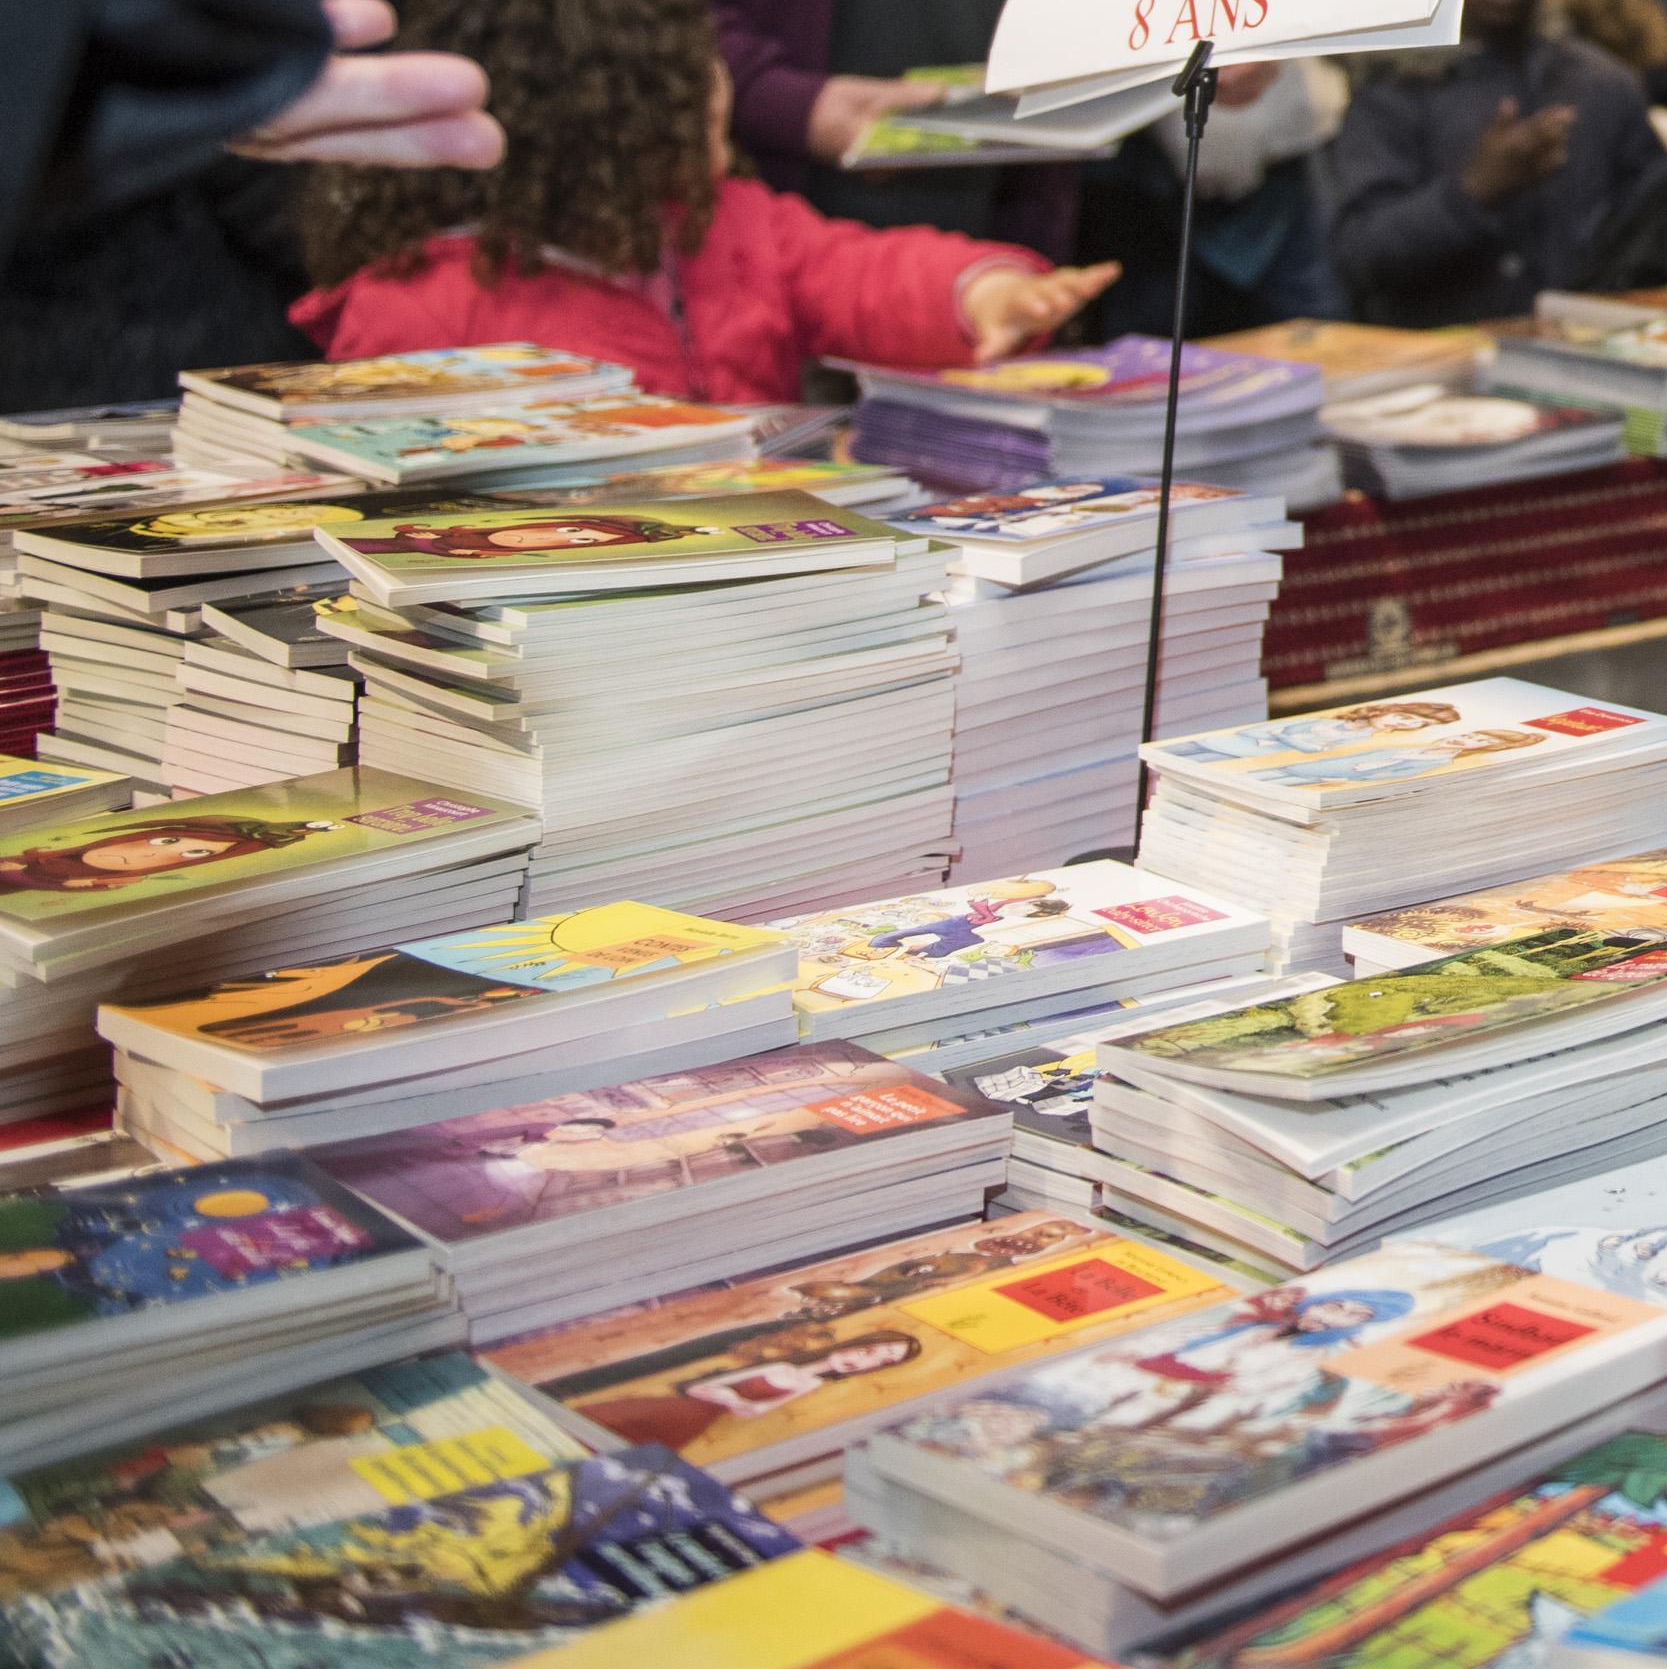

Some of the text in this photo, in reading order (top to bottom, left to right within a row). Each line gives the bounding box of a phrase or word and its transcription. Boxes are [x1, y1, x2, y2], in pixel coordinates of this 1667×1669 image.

[634, 939, 696, 952] CONTES
[1070, 1264, 1136, 1299] La Belle
